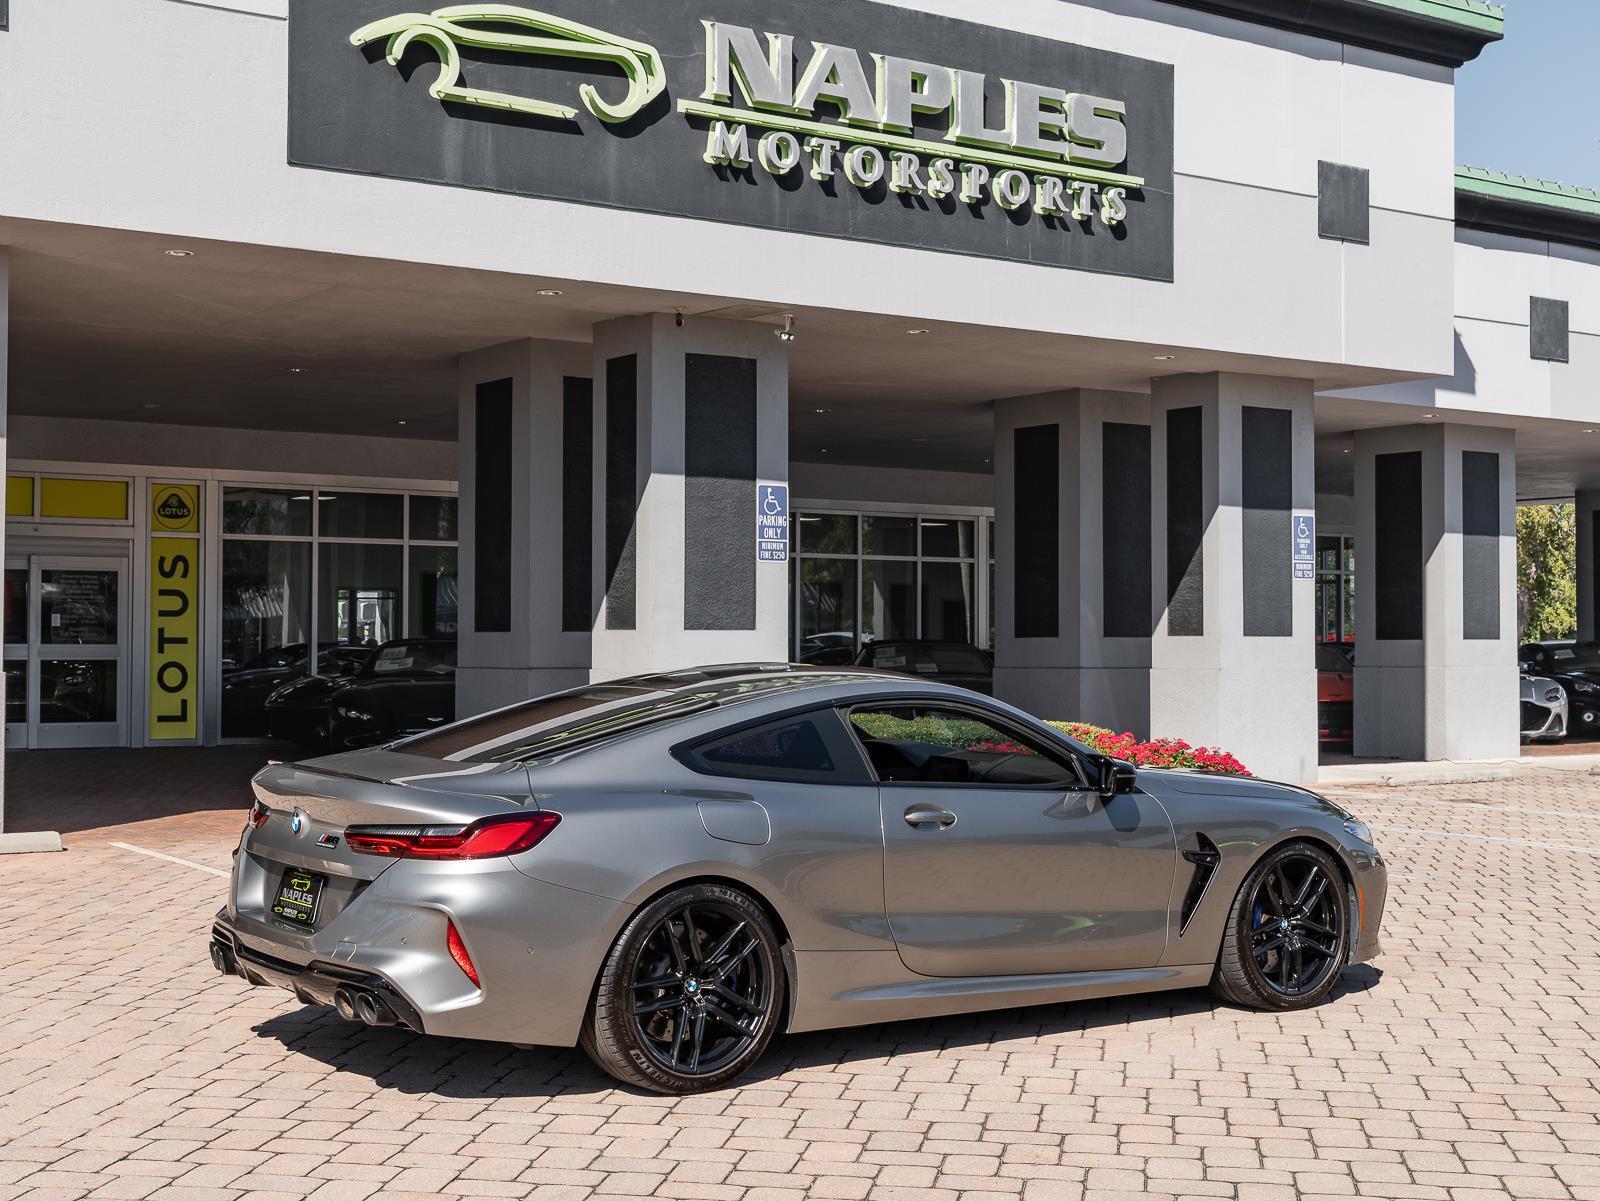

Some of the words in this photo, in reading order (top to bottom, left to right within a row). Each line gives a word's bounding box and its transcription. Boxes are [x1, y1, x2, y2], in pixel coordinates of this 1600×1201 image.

[700, 19, 1127, 168] NAPLES
[703, 121, 1127, 226] MOTORSPORTS
[160, 507, 189, 515] LOTUS
[759, 515, 787, 526] PARKING
[764, 527, 781, 539] ONLY
[761, 541, 784, 550] MINIMUM
[760, 550, 772, 559] FINE
[773, 551, 786, 560] $250
[157, 554, 189, 723] LOTUS
[282, 888, 313, 904] NAPLES
